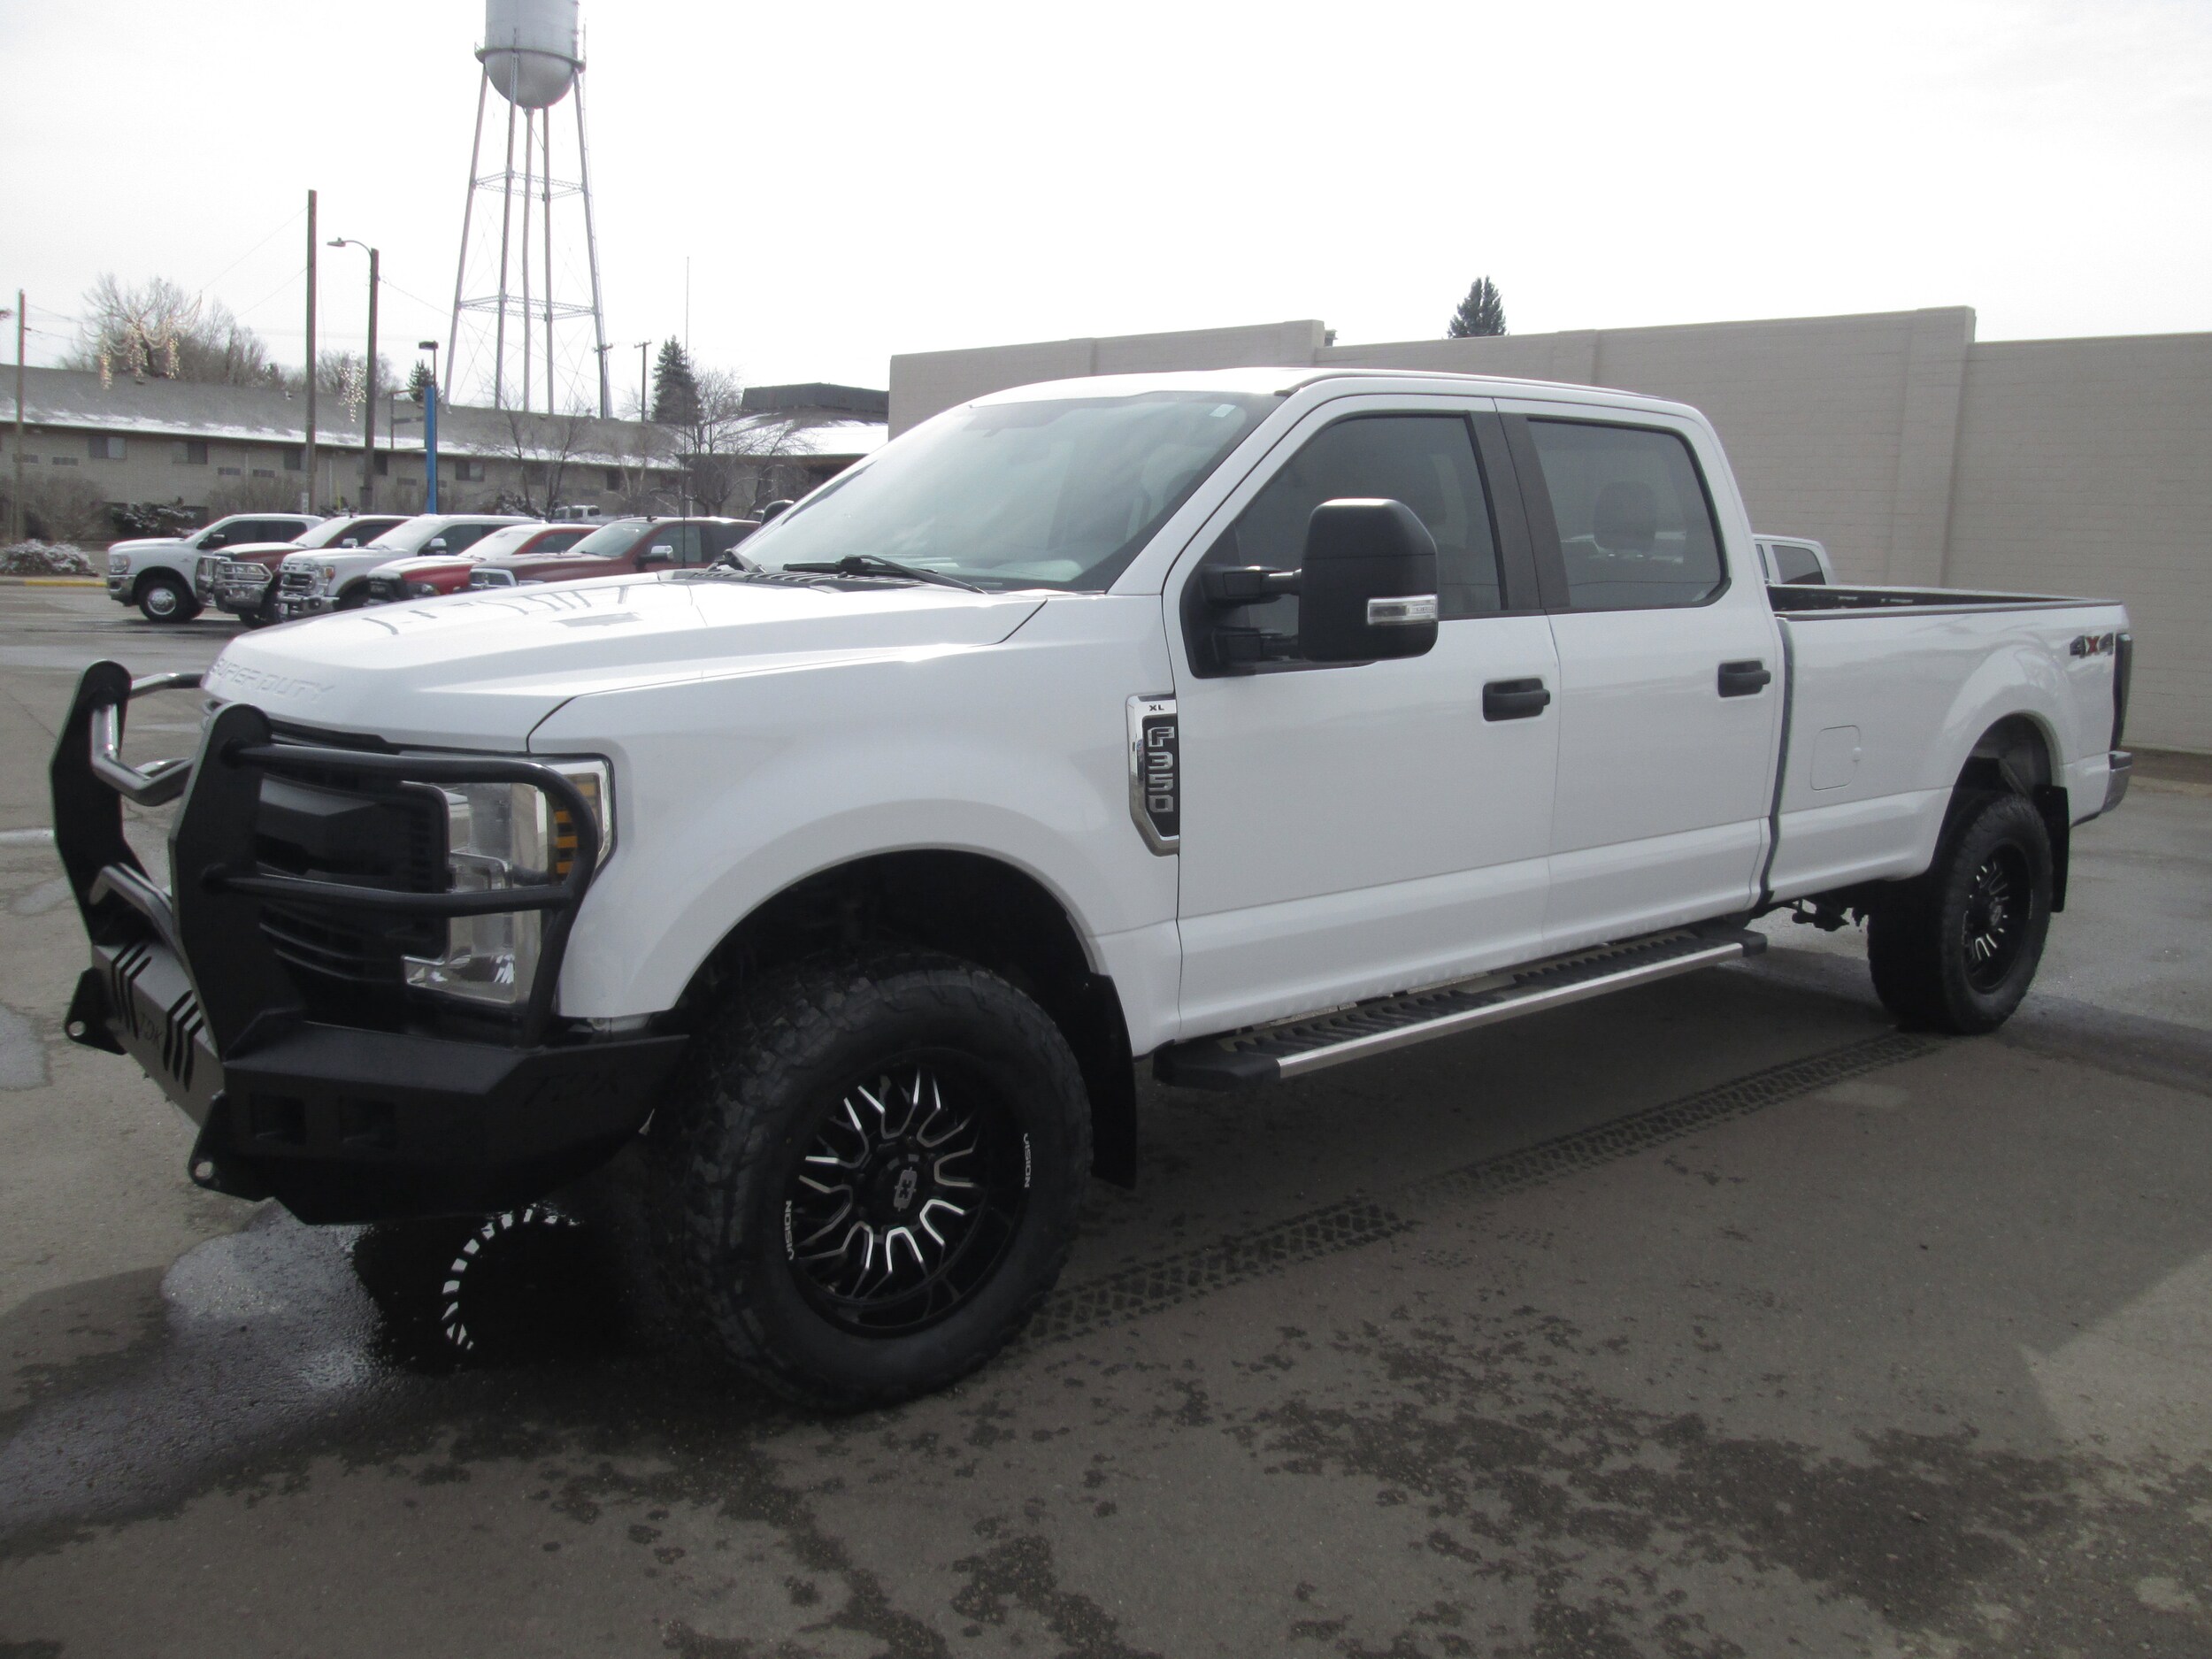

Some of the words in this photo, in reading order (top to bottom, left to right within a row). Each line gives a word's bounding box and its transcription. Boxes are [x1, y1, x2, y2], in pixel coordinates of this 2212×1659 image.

[1147, 726, 1175, 813] F350
[1023, 1133, 1032, 1188] VISION
[784, 1200, 795, 1261] VISION
